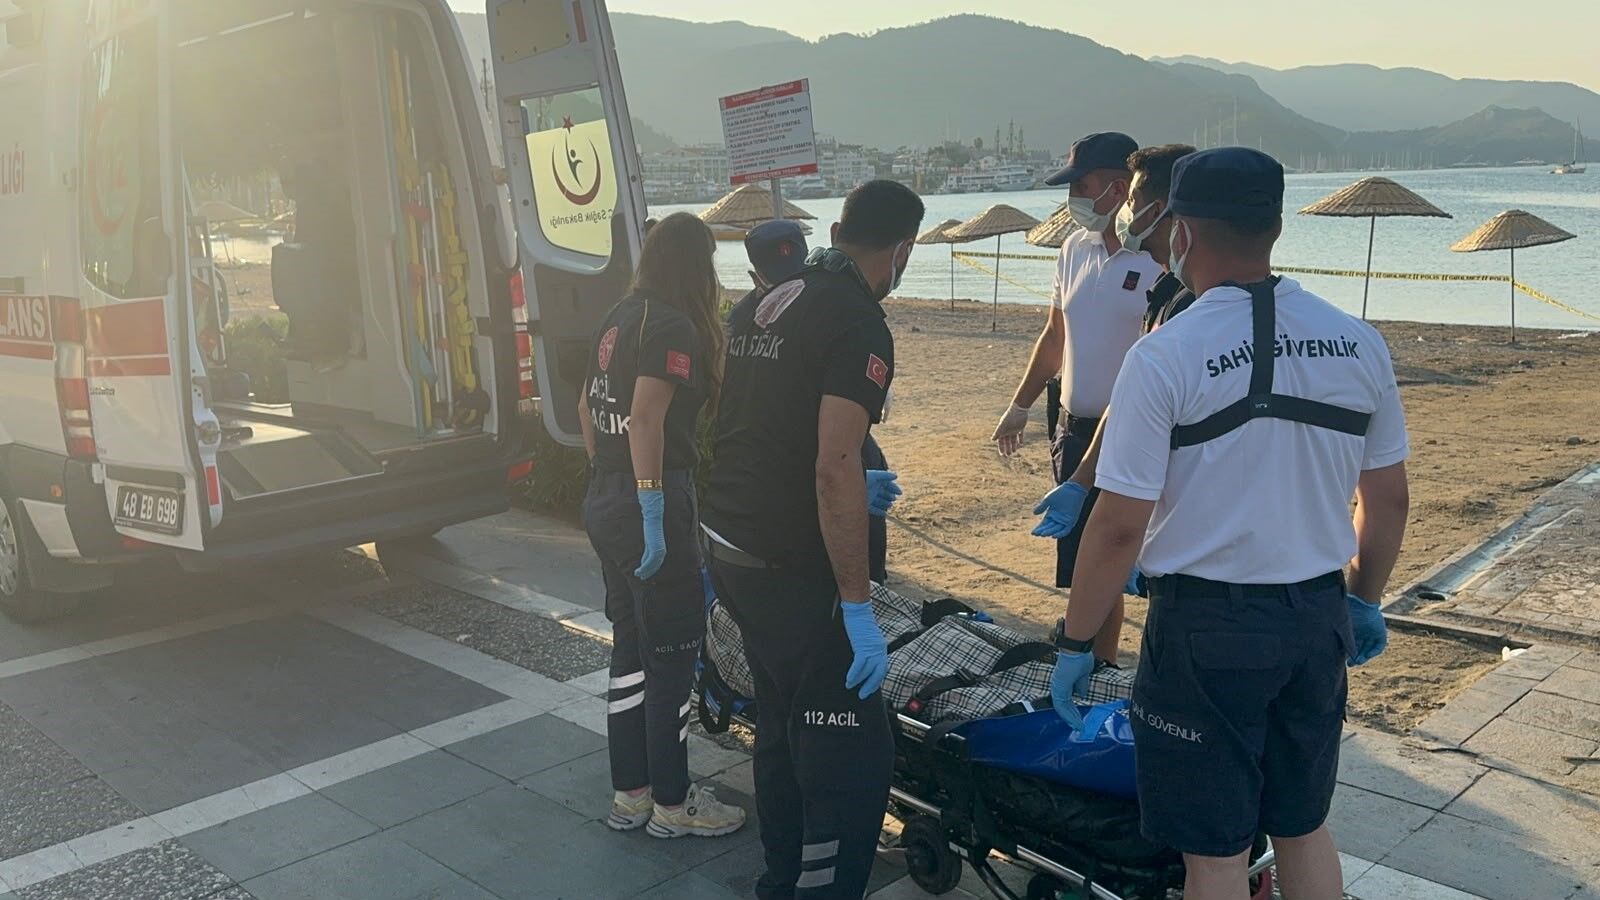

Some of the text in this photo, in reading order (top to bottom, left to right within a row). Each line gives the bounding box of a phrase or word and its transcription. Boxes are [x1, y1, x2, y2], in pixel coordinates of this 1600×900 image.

[1206, 340, 1255, 378] SAHİ
[122, 492, 178, 525] 48 EB 698
[804, 711, 860, 726] 112 ACİL
